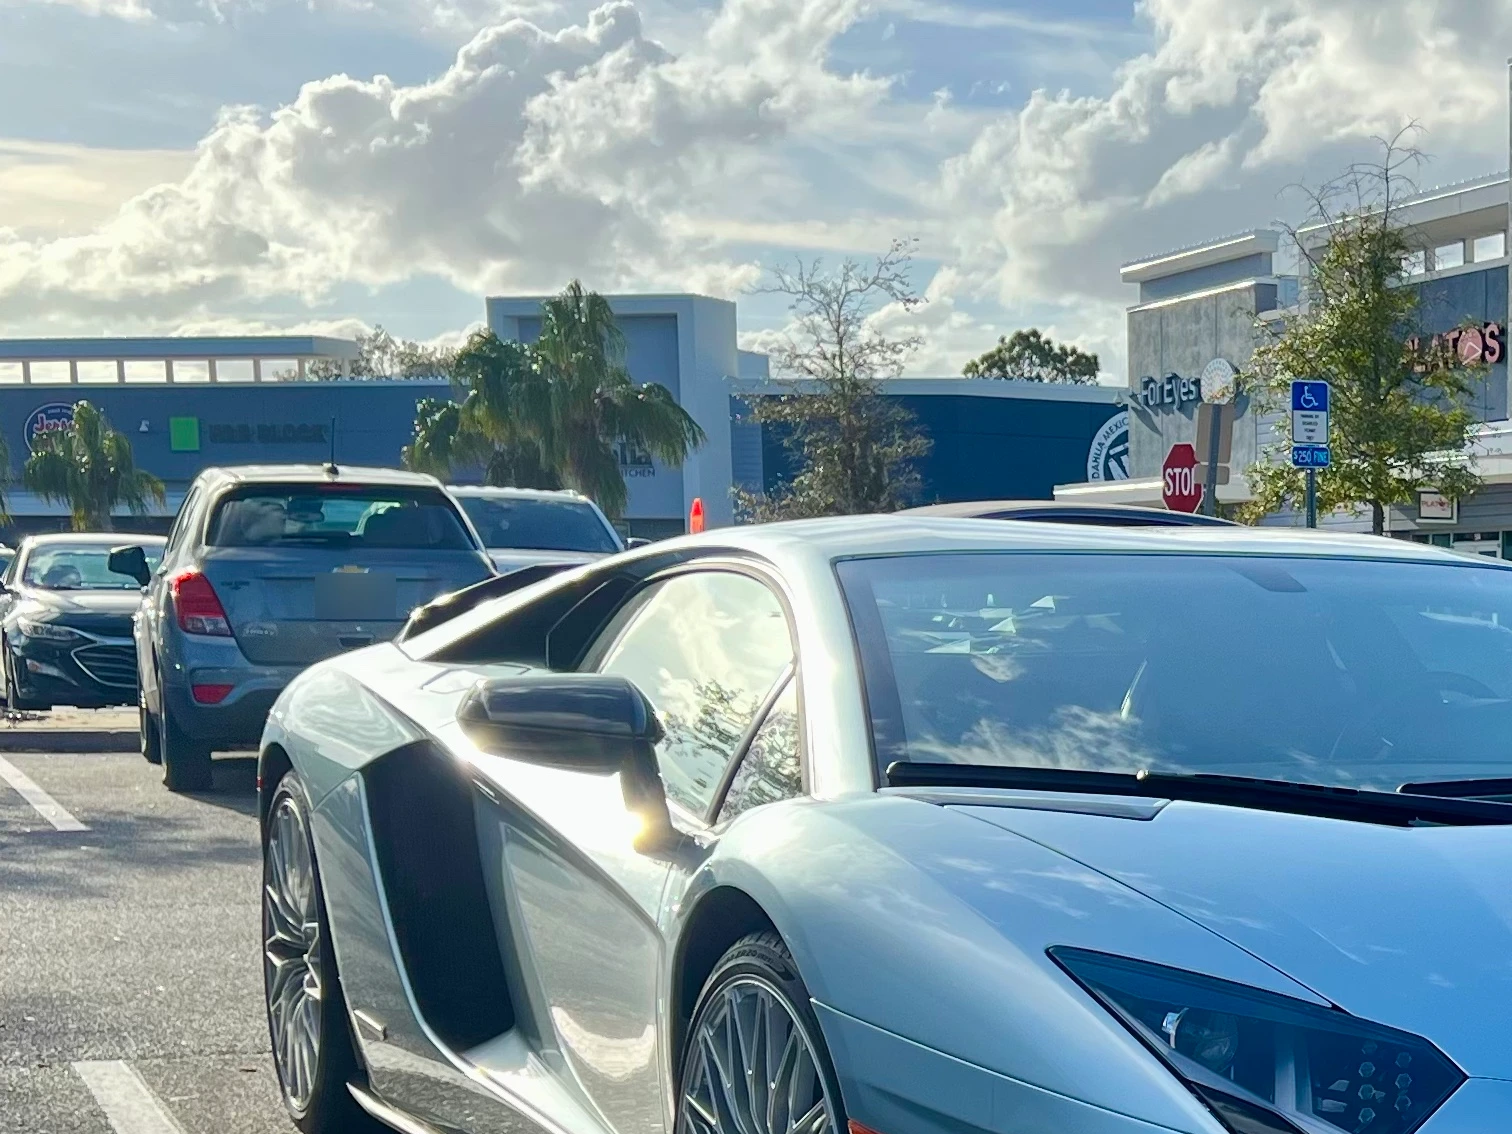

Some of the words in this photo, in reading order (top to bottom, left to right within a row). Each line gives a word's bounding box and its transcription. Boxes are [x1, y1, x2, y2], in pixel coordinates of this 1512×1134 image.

[1091, 441, 1105, 480] DAHLIA
[1103, 415, 1129, 442] MEXIC
[620, 467, 656, 478] ITCHEN
